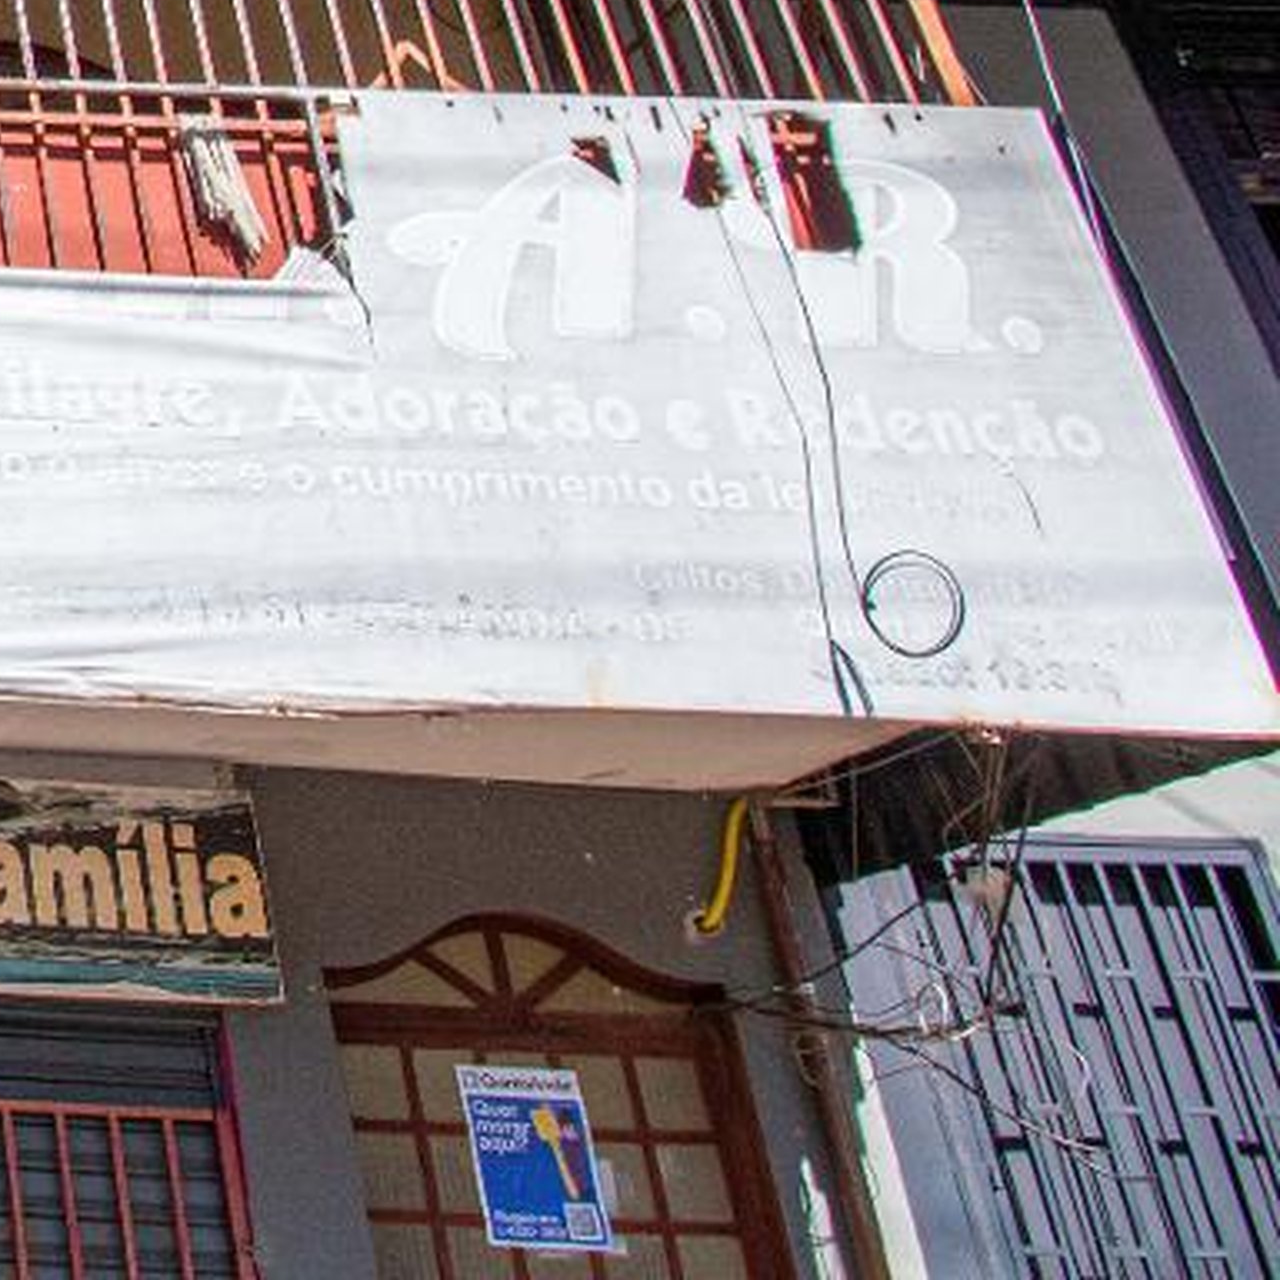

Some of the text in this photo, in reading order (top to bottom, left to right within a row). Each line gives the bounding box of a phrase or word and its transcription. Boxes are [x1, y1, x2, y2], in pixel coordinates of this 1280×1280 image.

[666, 397, 716, 451] e
[330, 464, 674, 508] cumprimento
[688, 468, 749, 509] da
